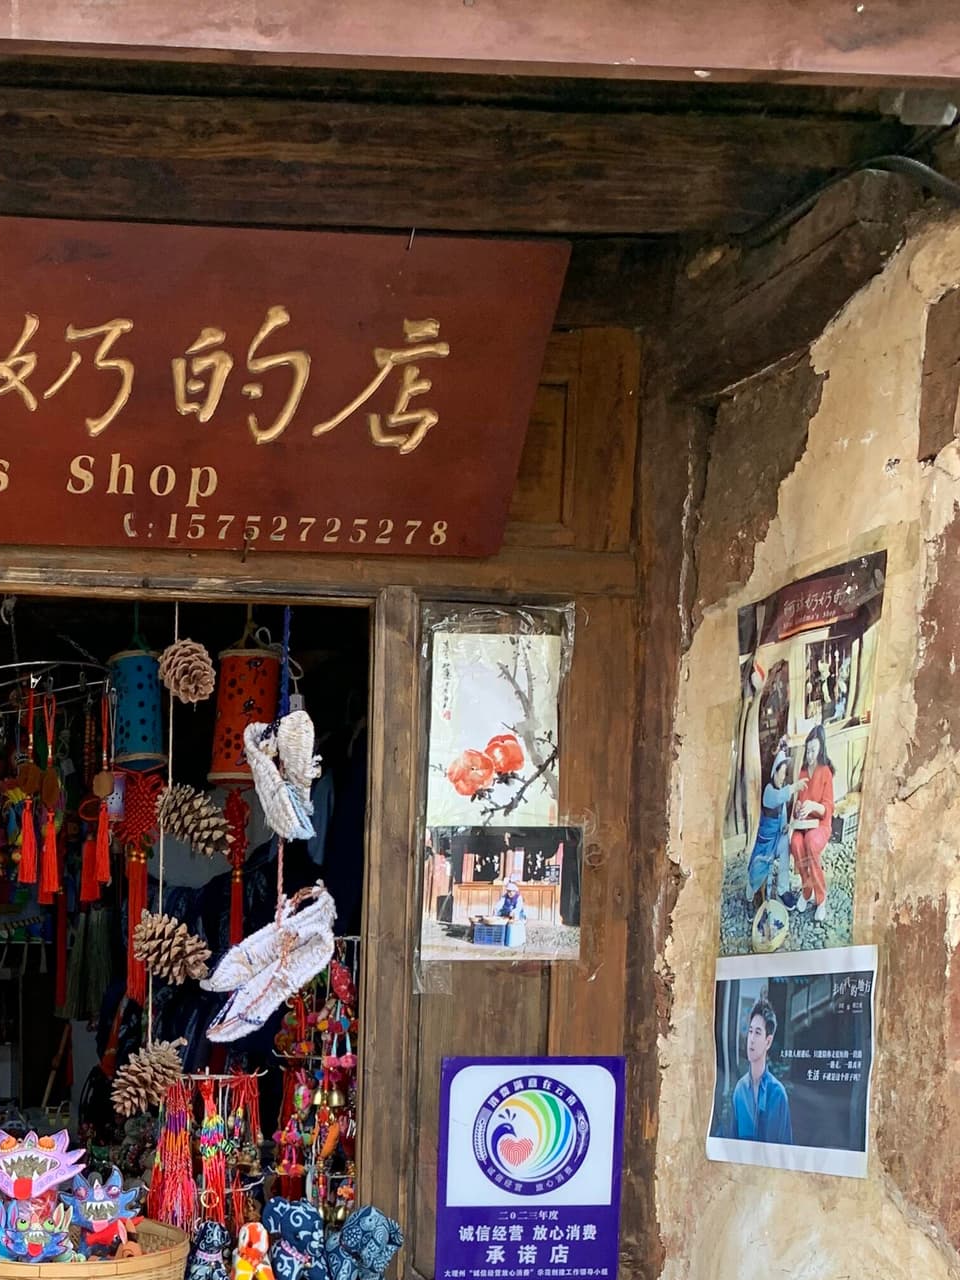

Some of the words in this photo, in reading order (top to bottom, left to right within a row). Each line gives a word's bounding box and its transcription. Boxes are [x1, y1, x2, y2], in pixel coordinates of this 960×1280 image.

[66, 452, 219, 508] Shop
[458, 1225, 524, 1242] 诚信经营
[532, 1224, 597, 1241] 放心消费
[485, 1244, 569, 1265] 承诺店
